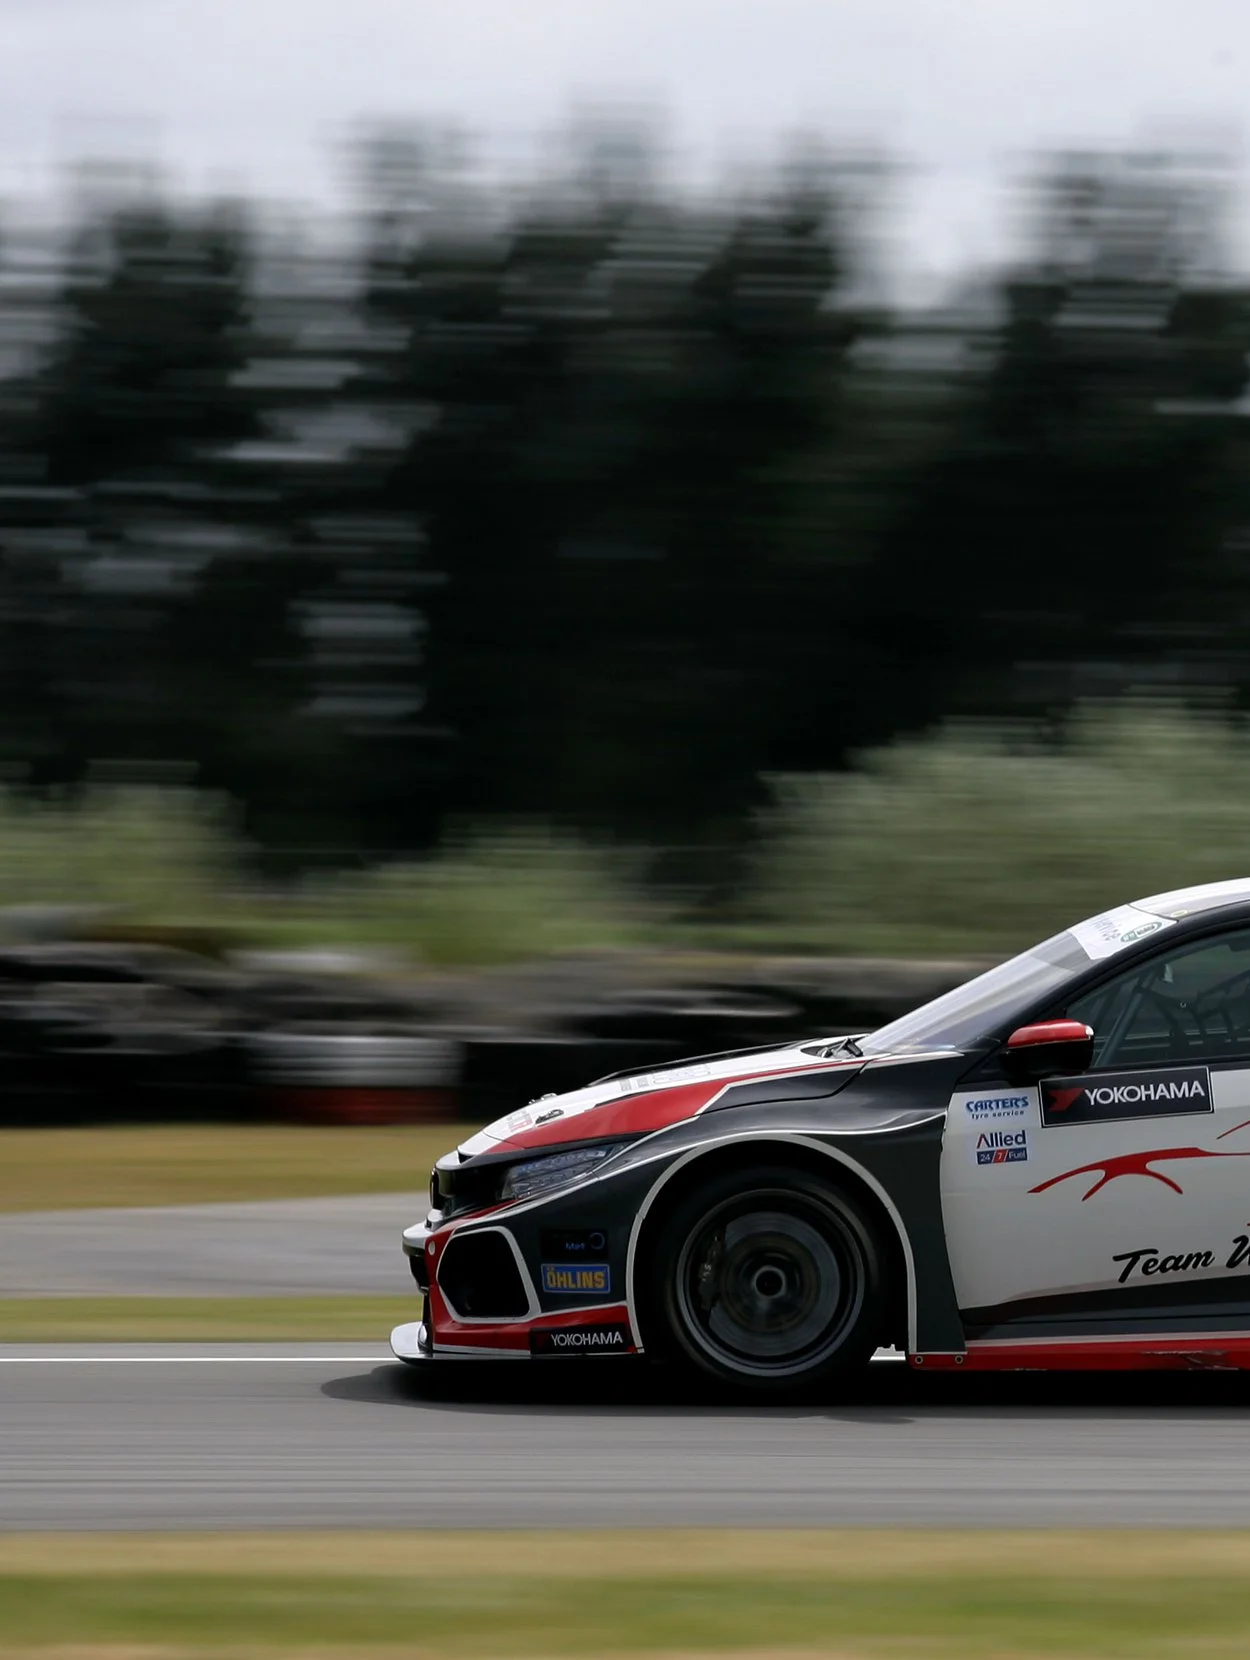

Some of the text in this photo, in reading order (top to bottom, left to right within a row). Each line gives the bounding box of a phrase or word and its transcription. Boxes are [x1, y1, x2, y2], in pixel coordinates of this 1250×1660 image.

[1084, 1080, 1205, 1106] YOKOHAMA
[977, 1130, 1026, 1149] Allied
[1112, 1249, 1215, 1283] Team
[551, 1331, 623, 1346] YOKOHAMA
